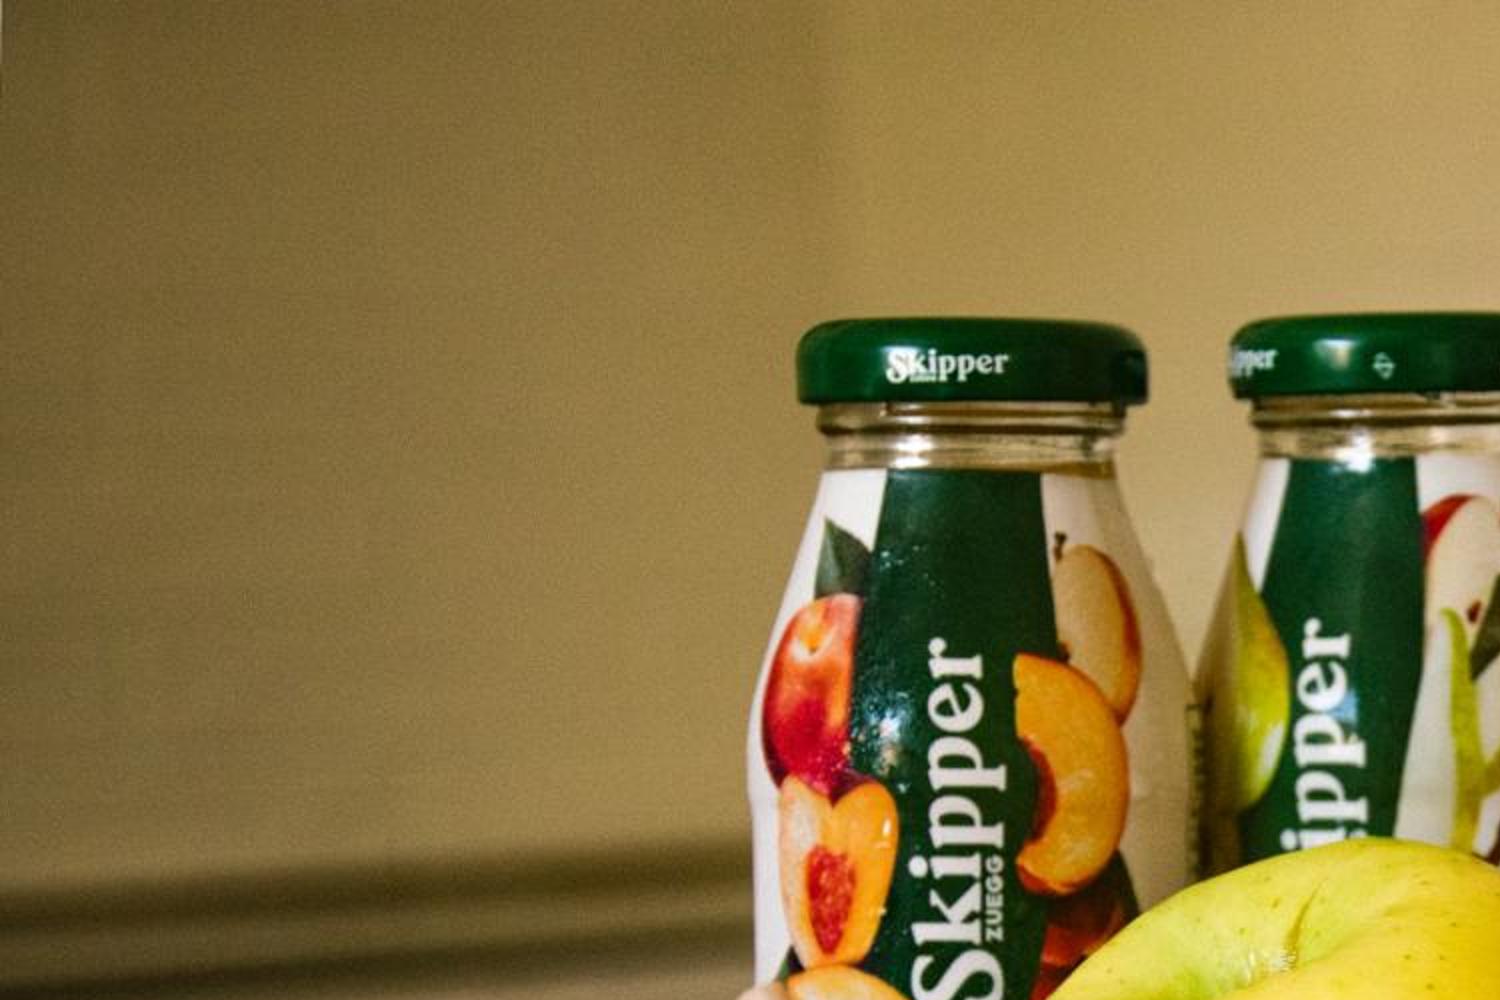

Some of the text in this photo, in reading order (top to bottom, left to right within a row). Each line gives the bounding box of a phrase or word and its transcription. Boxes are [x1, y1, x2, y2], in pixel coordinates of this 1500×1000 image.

[886, 347, 1009, 384] Skipper
[1280, 618, 1368, 850] ipper
[984, 854, 1004, 942] ZUEGG
